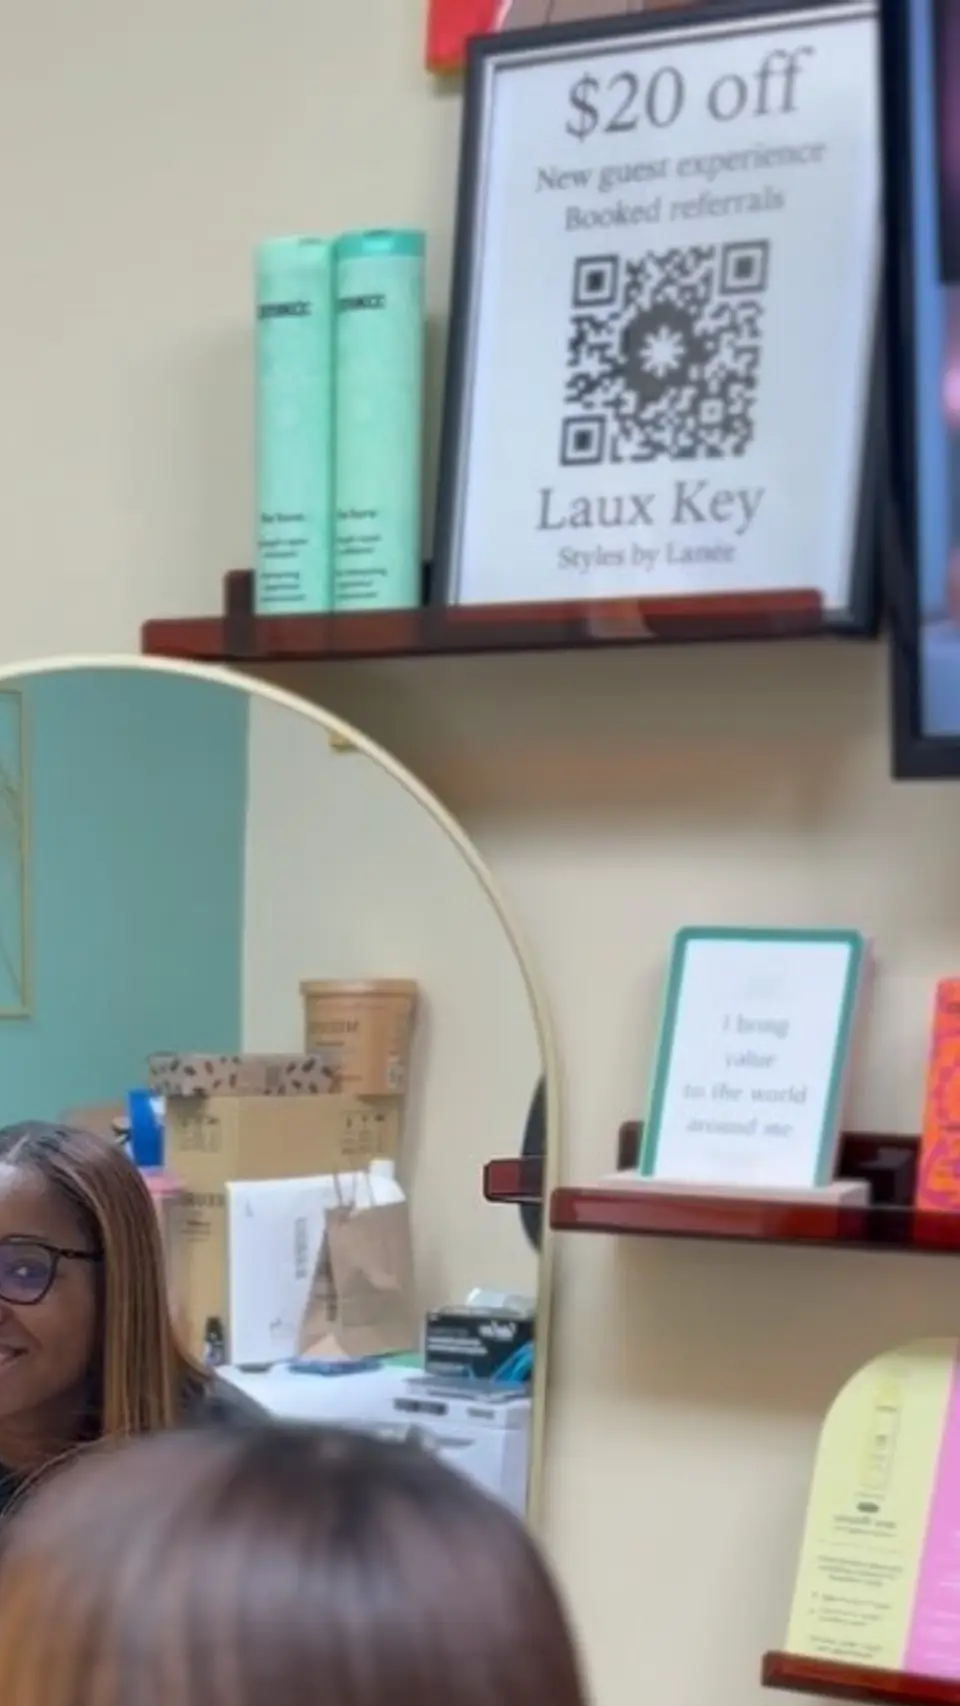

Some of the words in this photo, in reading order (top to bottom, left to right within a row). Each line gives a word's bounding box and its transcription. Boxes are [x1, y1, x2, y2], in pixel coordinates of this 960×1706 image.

[565, 64, 686, 142] $20
[707, 45, 816, 123] off
[535, 167, 593, 192] New
[597, 157, 670, 192] guest
[676, 141, 827, 183] experience
[564, 197, 662, 231] Booked
[668, 184, 786, 222] referrals
[535, 486, 657, 532] Laux
[670, 478, 767, 536] Key
[557, 544, 626, 574] Styles
[631, 541, 662, 572] by
[750, 1083, 808, 1105] world
